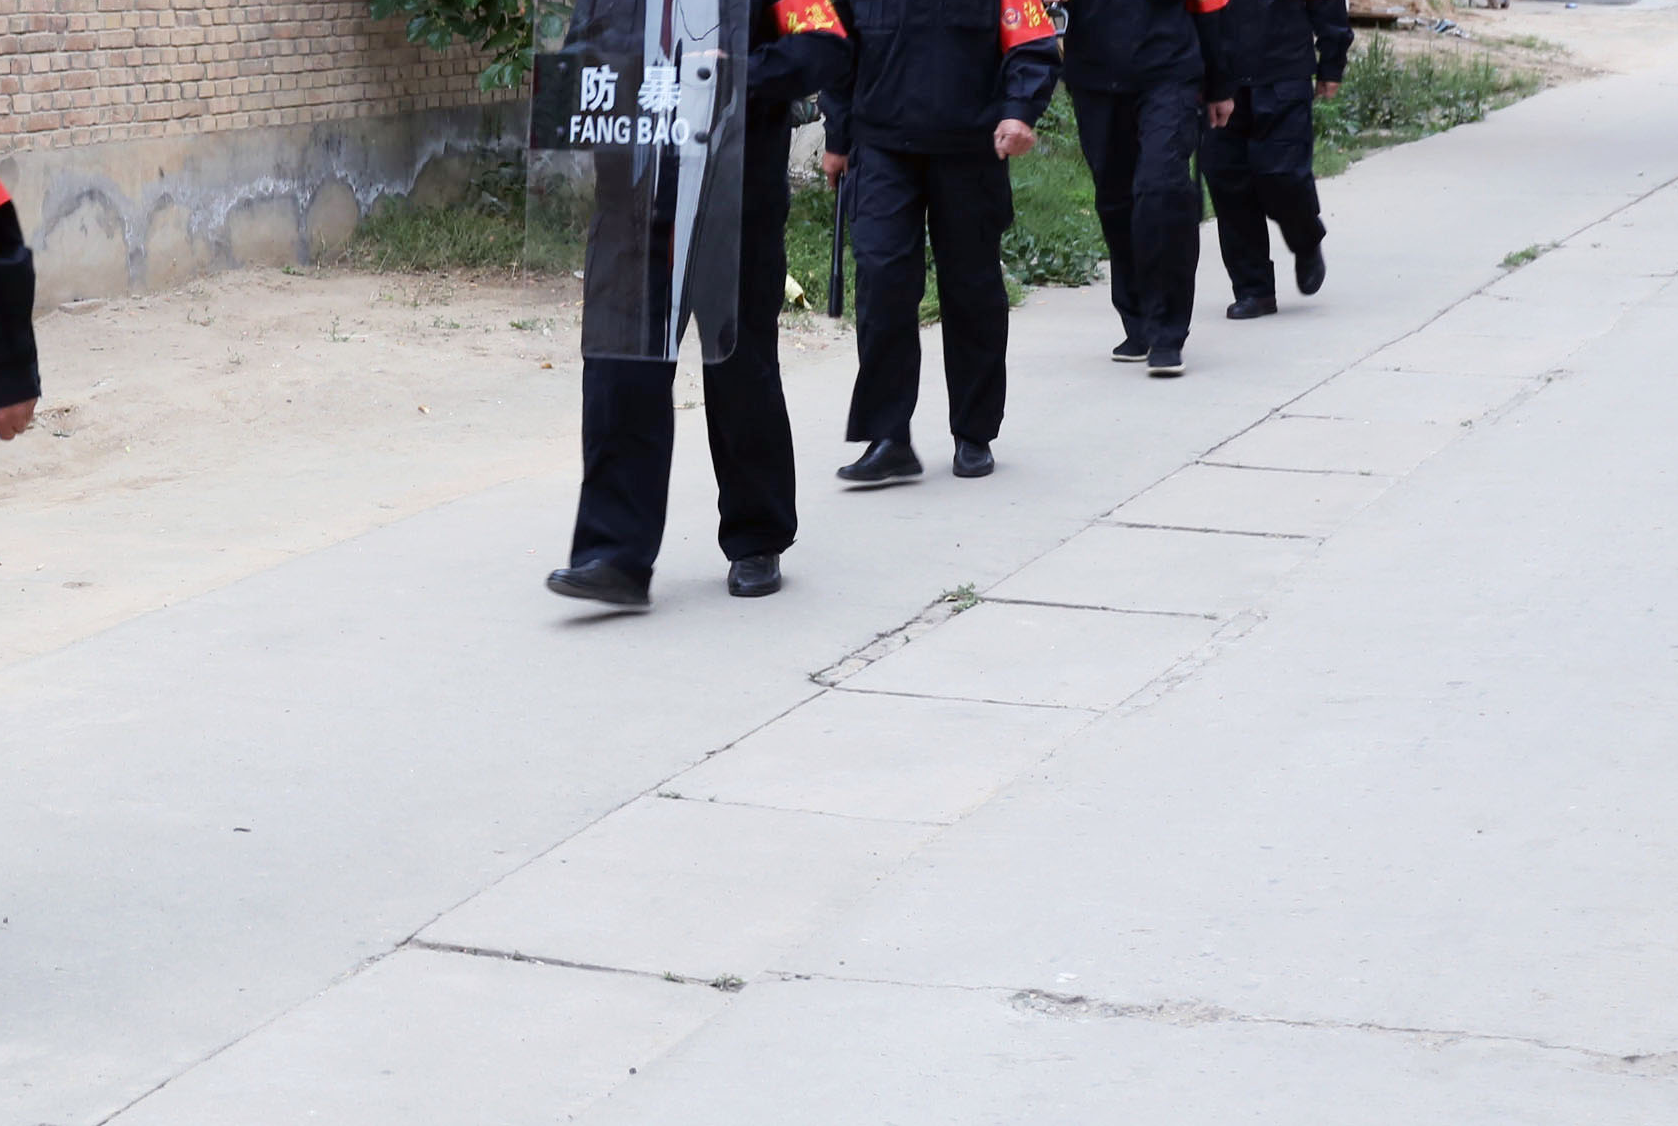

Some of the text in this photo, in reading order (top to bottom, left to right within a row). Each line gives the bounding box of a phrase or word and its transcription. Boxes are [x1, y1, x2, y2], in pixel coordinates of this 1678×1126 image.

[579, 64, 681, 113] 防暴
[569, 114, 690, 146] FANG BAO
